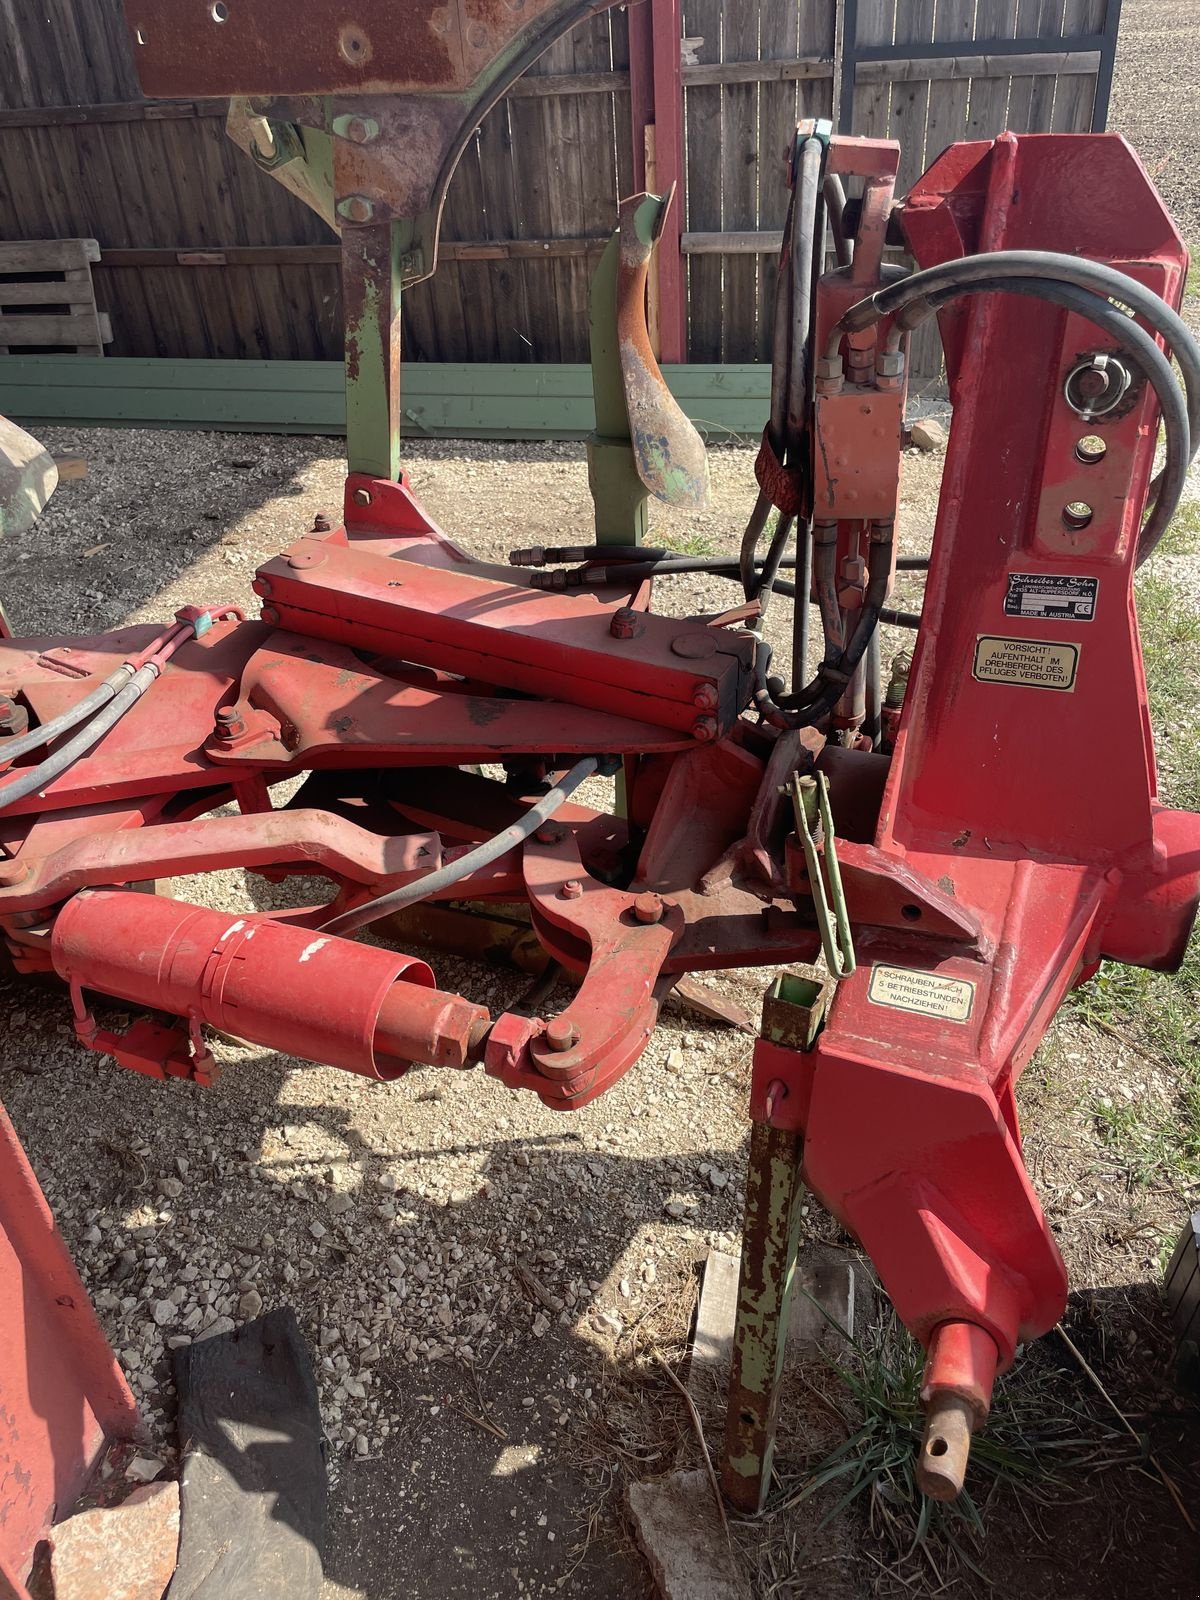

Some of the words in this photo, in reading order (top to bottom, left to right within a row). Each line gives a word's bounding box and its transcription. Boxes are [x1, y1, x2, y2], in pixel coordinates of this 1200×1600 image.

[1011, 574, 1054, 585] Schreiber
[1066, 577, 1095, 587] Sohn
[1048, 611, 1076, 619] AUSTRIA
[1076, 604, 1091, 613] CE
[1003, 643, 1051, 655] VORSICHT!
[990, 652, 1046, 664] AUFENTHALT
[1050, 657, 1061, 666] IM
[985, 659, 1043, 672] DREHBEREICH
[1046, 665, 1064, 674] DES
[979, 666, 1017, 677] PFLUGES
[1019, 671, 1068, 683] VERBOTEN!
[883, 971, 935, 988] SCHRAUBEN
[938, 982, 963, 994] ACH
[887, 982, 964, 1005] BETRIEBSTUNDEN
[889, 993, 949, 1011] NACHZIEHEN!
